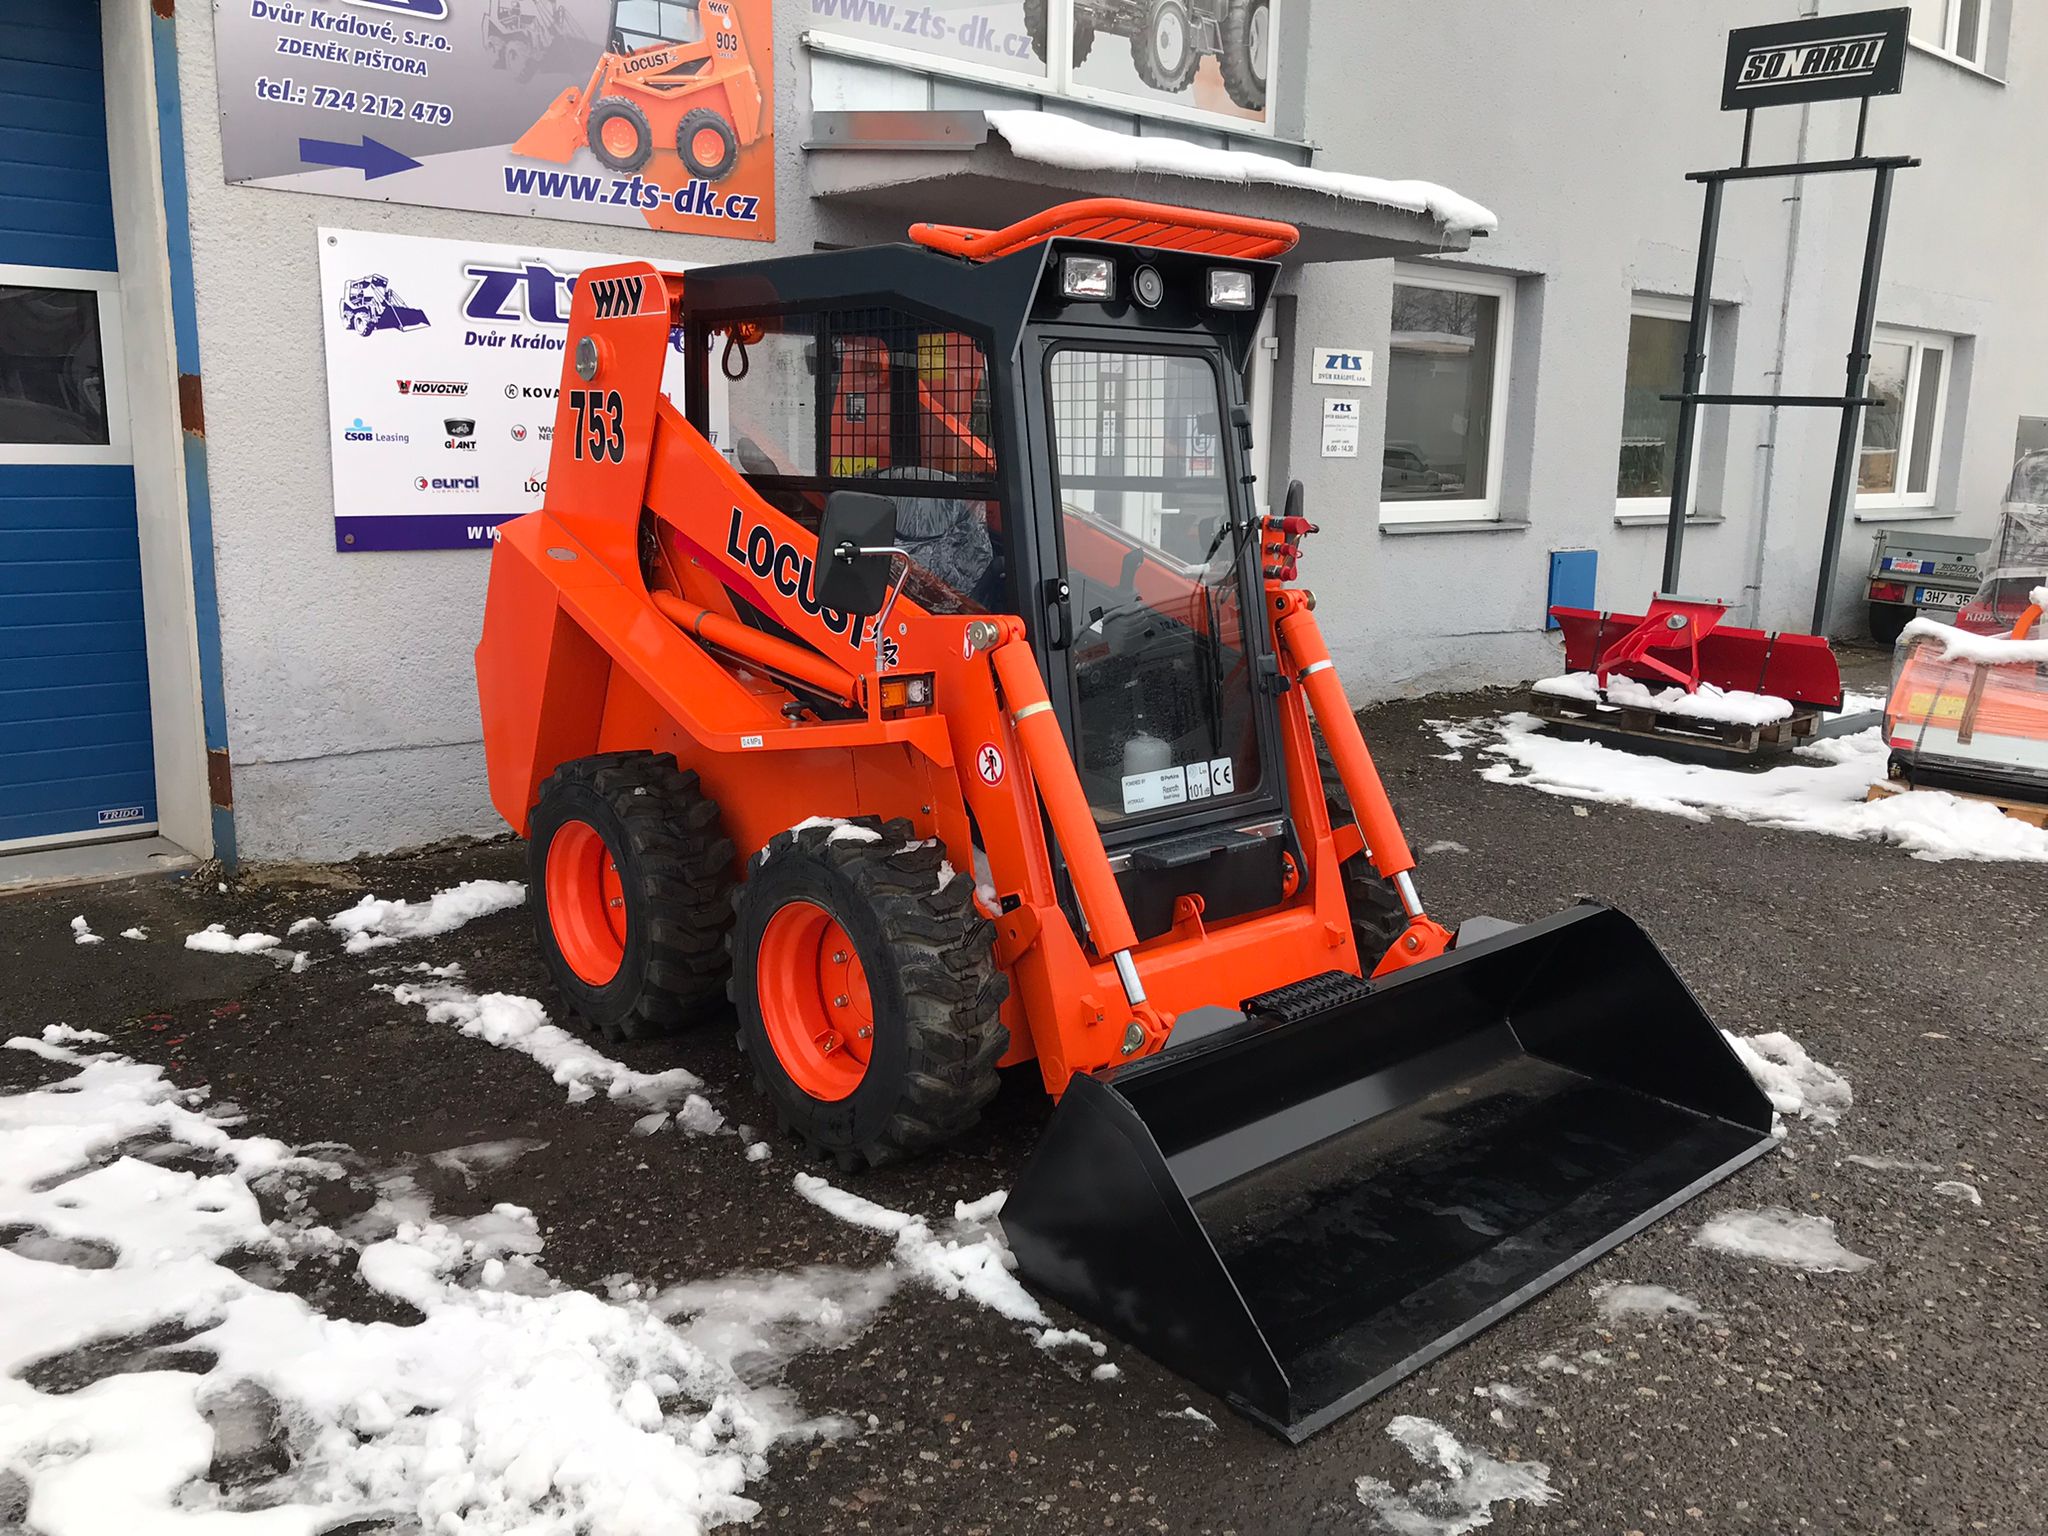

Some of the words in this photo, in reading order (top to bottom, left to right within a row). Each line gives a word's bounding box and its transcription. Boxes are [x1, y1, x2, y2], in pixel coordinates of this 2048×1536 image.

[251, 0, 305, 24] Dvůr
[311, 10, 397, 43] Králové,
[404, 30, 452, 51] s.r.o.
[716, 32, 737, 51] 903
[277, 38, 349, 62] ZDENĚK
[354, 50, 427, 75] PIŠTORA
[623, 52, 669, 74] LOCUST
[1741, 40, 1882, 82] SONAROL
[257, 78, 305, 103] tel.:
[314, 87, 355, 110] 724
[363, 95, 403, 117] 212
[412, 103, 451, 124] 479
[504, 167, 759, 219] www.zts-dk.cz
[466, 265, 578, 324] zt
[590, 276, 644, 319] WAY
[465, 331, 506, 347] Dvůr
[1325, 354, 1362, 370] zts
[1332, 403, 1352, 412] zts
[570, 390, 625, 464] 753
[344, 432, 373, 441] ČSOB
[376, 433, 409, 444] Leasing
[432, 475, 480, 489] eurol
[1925, 590, 1947, 604] 3H7
[1189, 783, 1203, 798] 101
[103, 809, 139, 820] TRIDO
